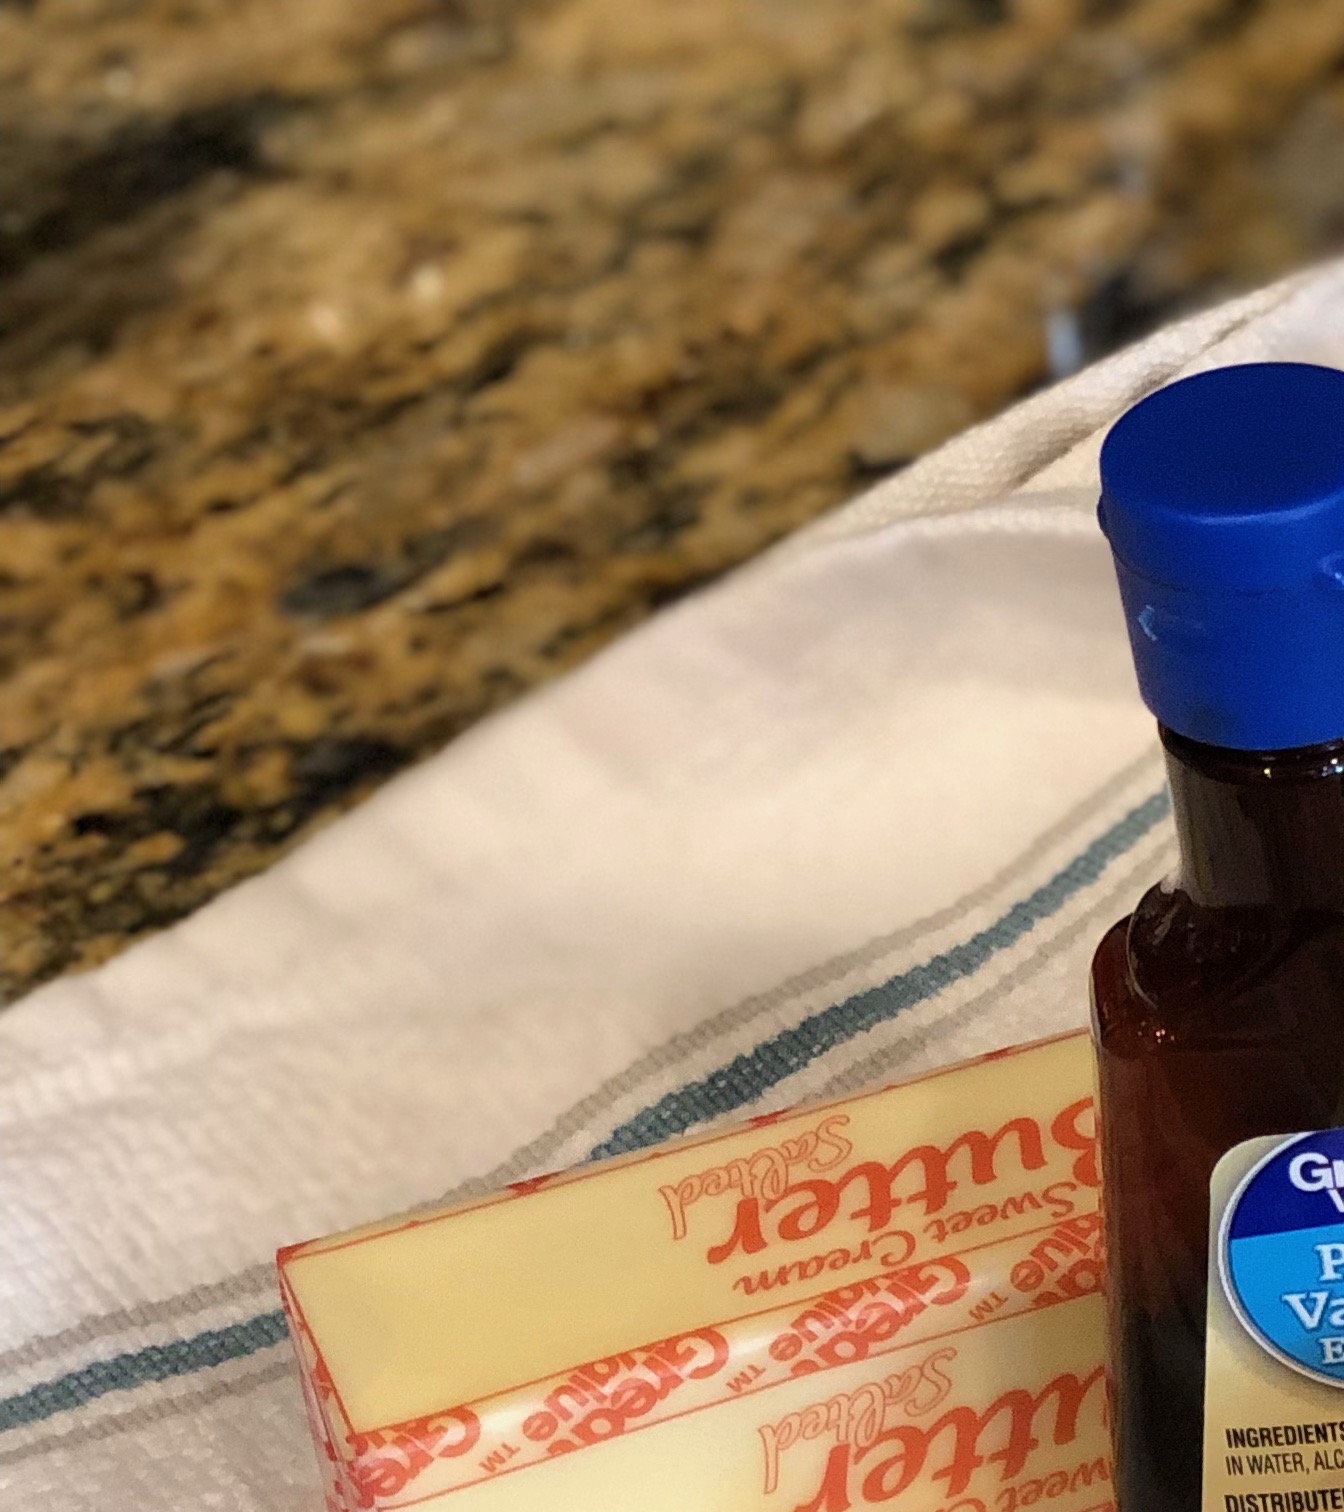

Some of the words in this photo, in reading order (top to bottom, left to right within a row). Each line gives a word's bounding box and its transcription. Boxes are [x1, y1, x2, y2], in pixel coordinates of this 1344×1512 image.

[658, 1113, 853, 1241] Salted
[706, 1095, 1102, 1265] Butter
[924, 1180, 1078, 1244] Sweet
[732, 1230, 917, 1296] Cream
[757, 1346, 957, 1495] Salted
[1225, 1455, 1245, 1476] IN
[1246, 1451, 1310, 1475] WATER,
